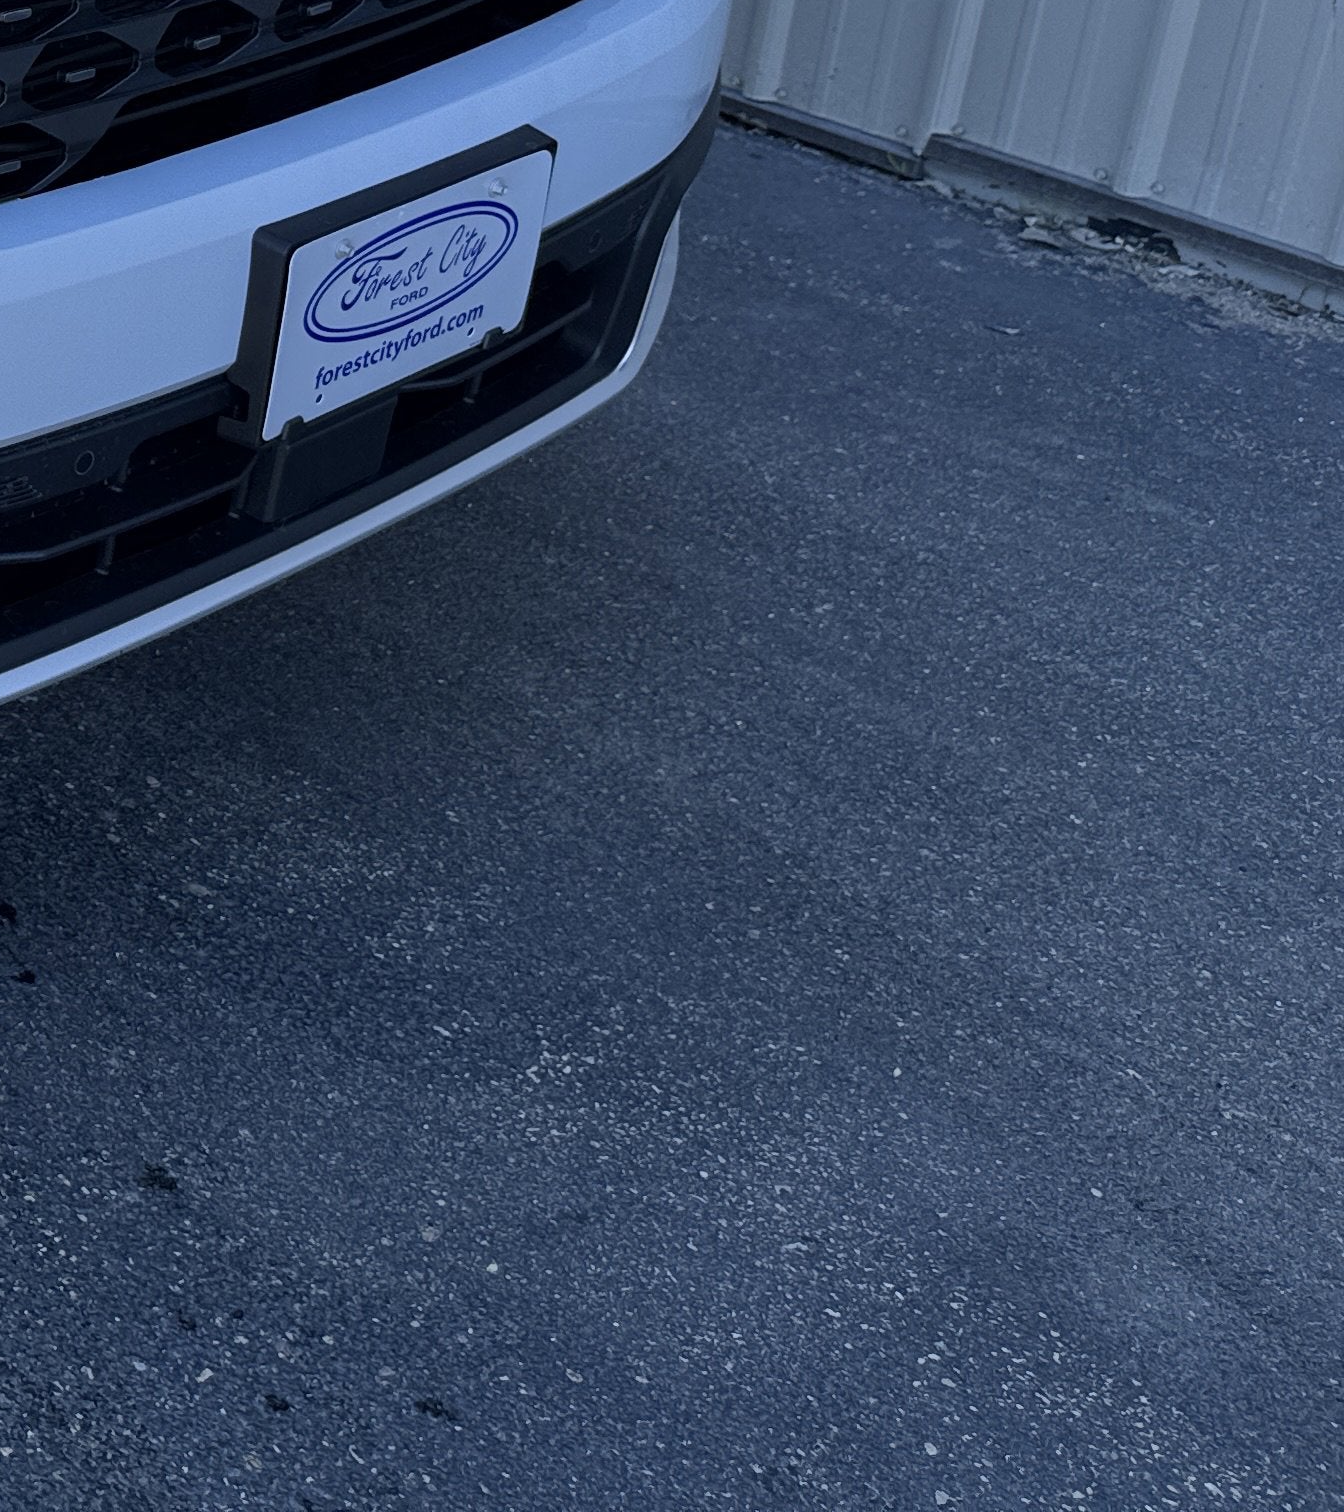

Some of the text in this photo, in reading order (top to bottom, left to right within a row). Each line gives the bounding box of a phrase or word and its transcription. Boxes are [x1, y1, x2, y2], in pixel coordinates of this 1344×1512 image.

[341, 224, 487, 311] Forest City
[390, 286, 429, 310] FORD
[315, 304, 484, 389] forestcityford.com
